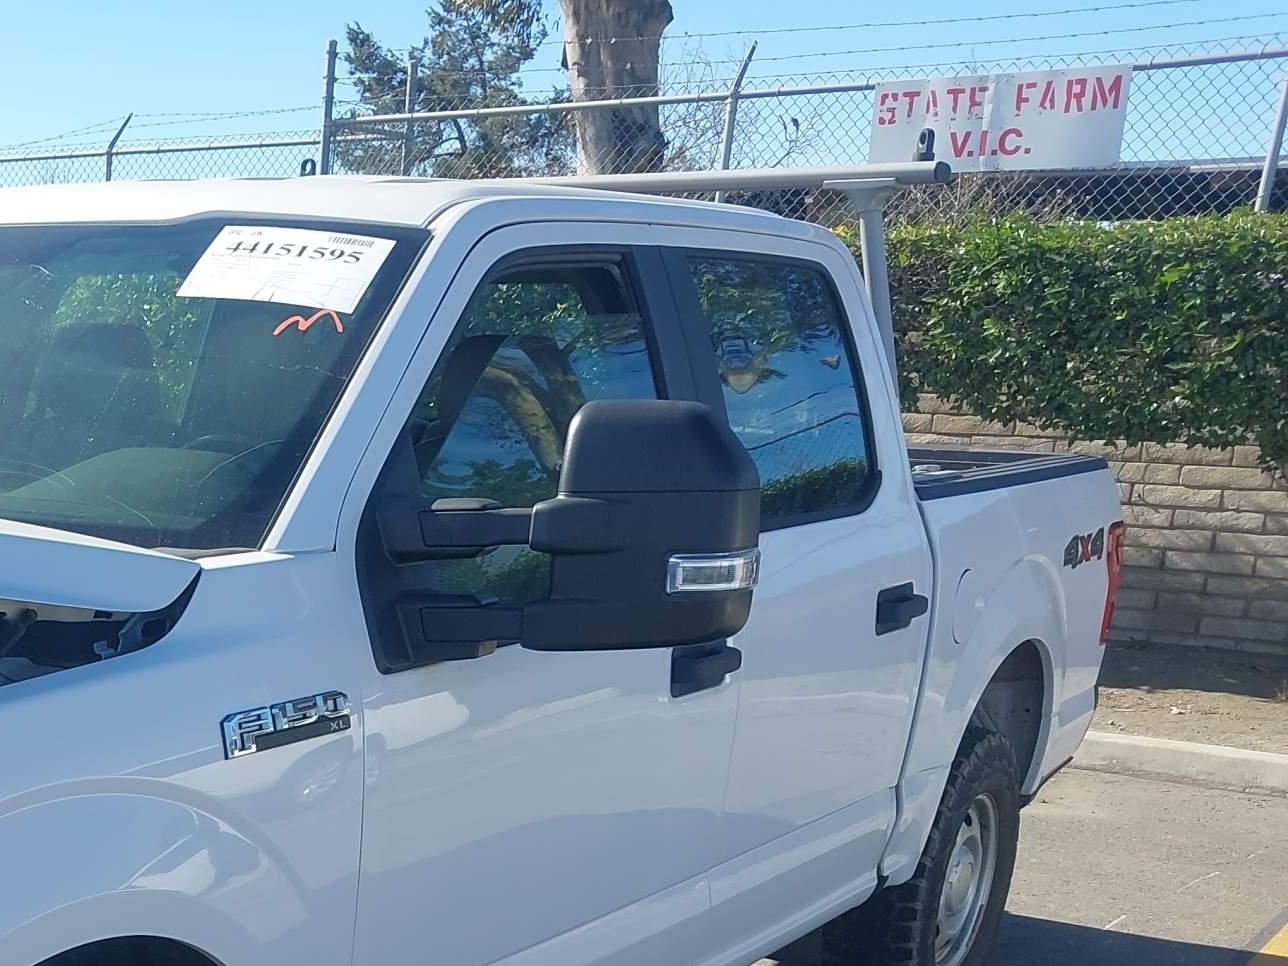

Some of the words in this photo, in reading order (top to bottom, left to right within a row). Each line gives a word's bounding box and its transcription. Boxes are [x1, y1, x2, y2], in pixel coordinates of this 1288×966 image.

[877, 85, 990, 126] STATE
[1013, 74, 1123, 117] FARM
[949, 127, 1032, 158] V.I.C.
[225, 240, 365, 265] 44151595
[329, 719, 348, 731] XL
